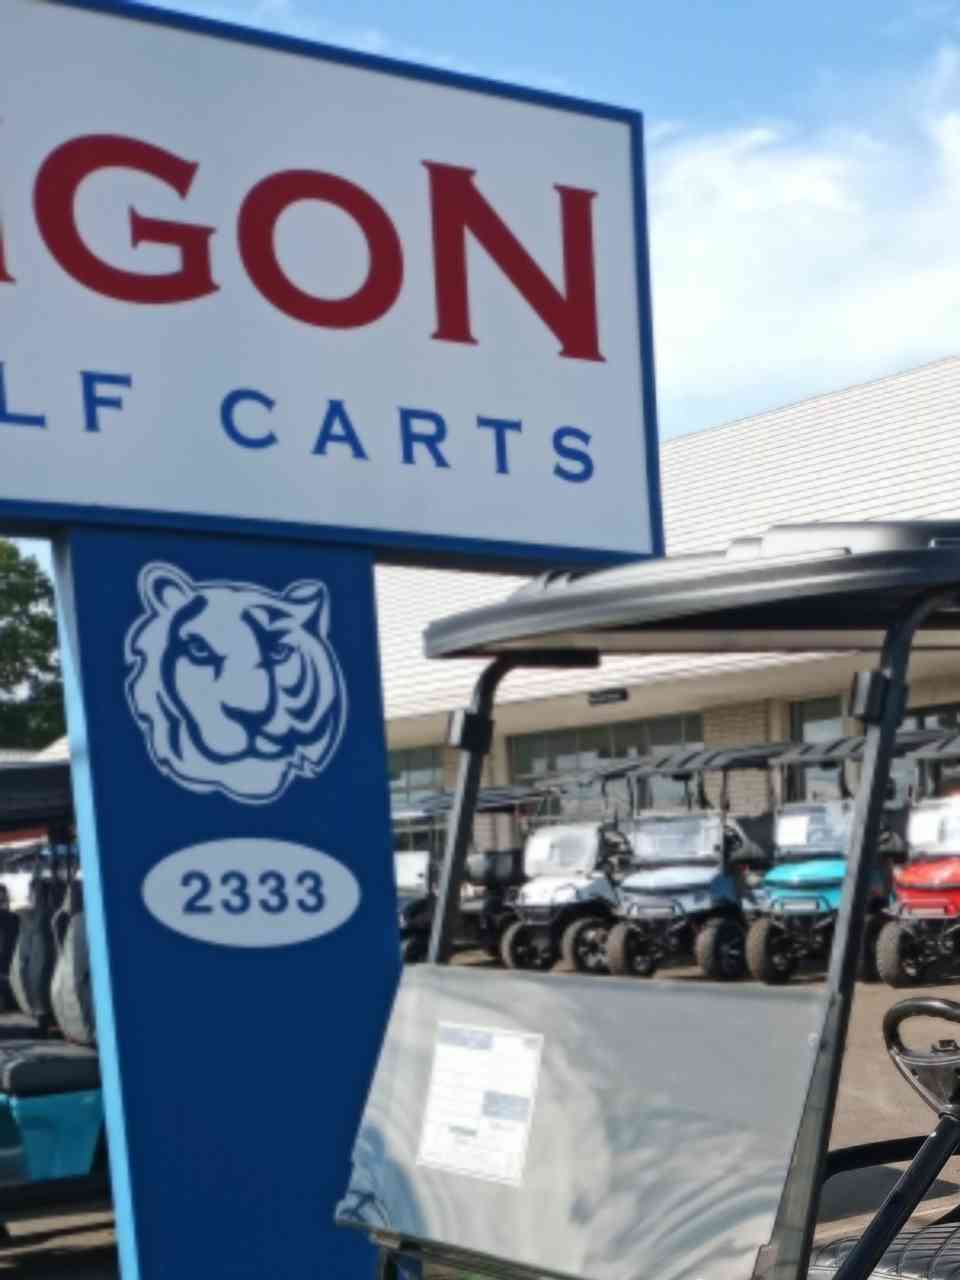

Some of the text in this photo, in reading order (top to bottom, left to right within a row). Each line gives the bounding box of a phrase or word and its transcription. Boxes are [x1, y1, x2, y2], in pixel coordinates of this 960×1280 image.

[0, 133, 607, 363] GON
[219, 388, 594, 484] CARTS
[180, 869, 326, 915] 2333
